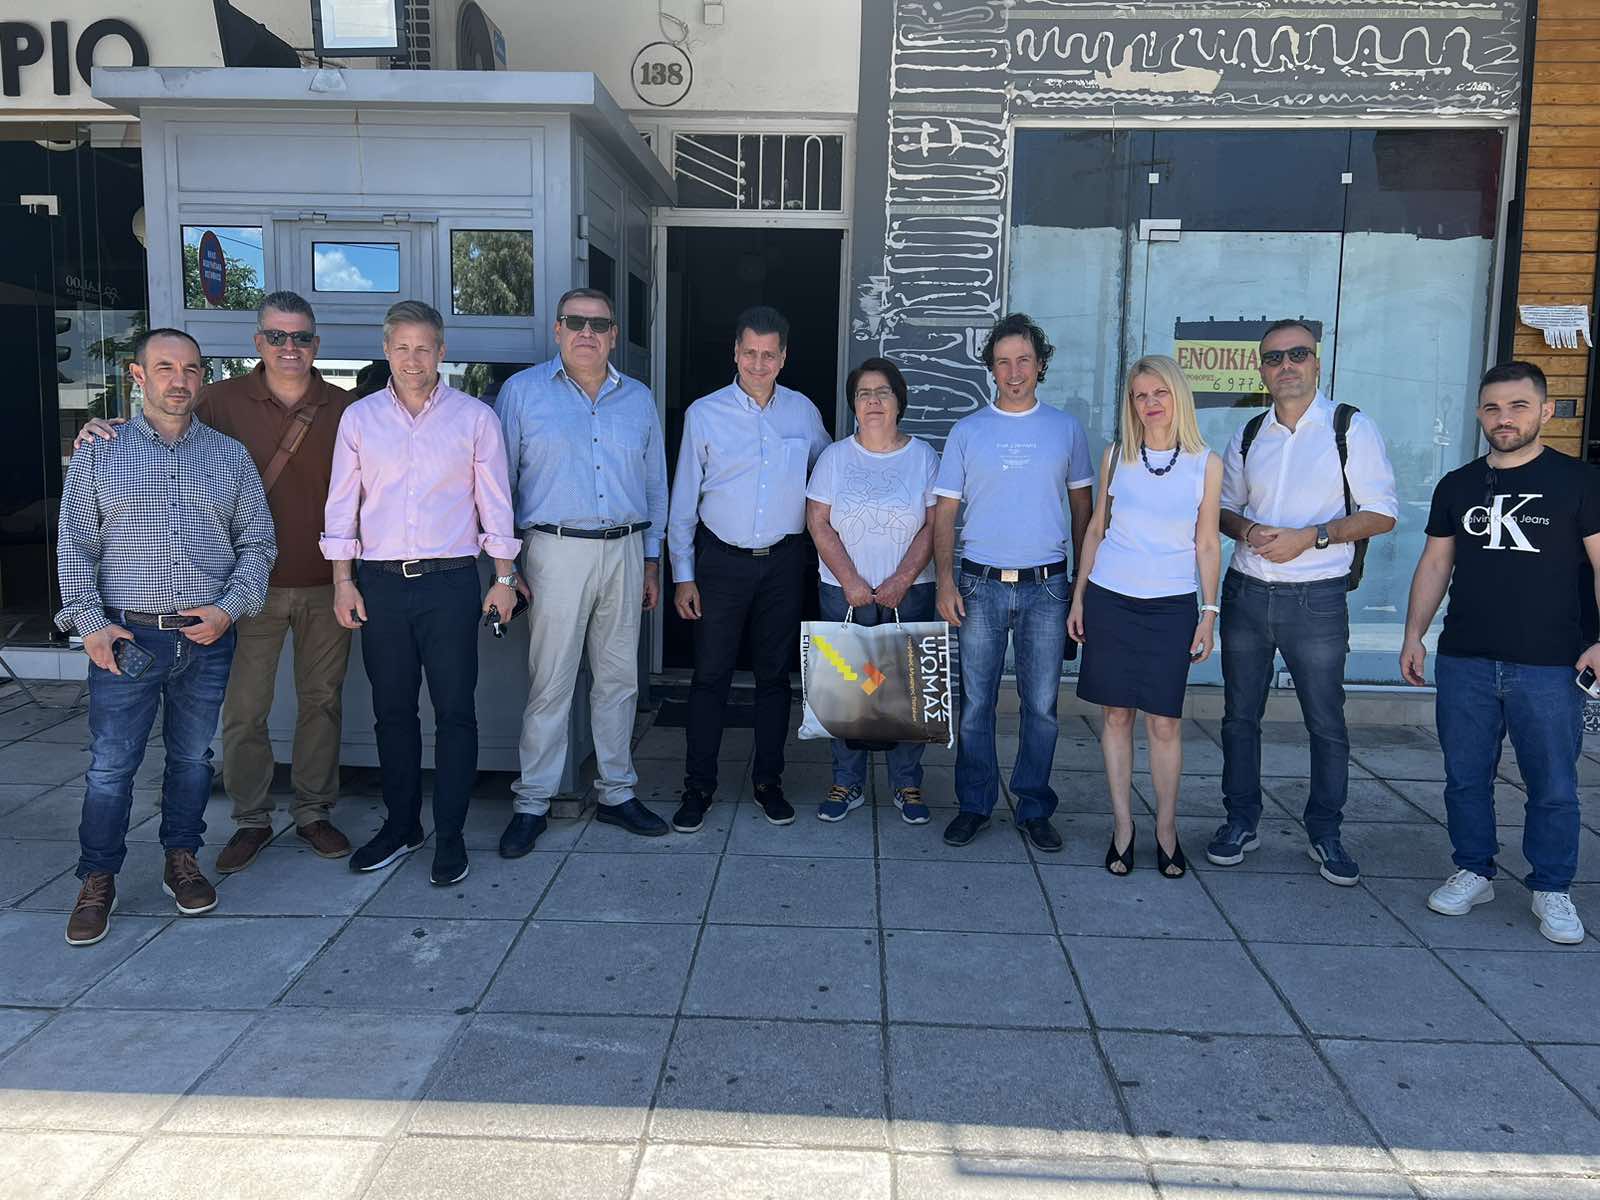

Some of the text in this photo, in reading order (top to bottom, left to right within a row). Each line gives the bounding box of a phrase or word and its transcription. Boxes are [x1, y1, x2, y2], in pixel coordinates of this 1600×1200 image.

[640, 62, 684, 86] 138
[1178, 347, 1261, 370] ΕΝΟΙΚΙΑ
[1520, 514, 1550, 526] Jeans
[919, 636, 942, 723] ΨΩΜΑΣ
